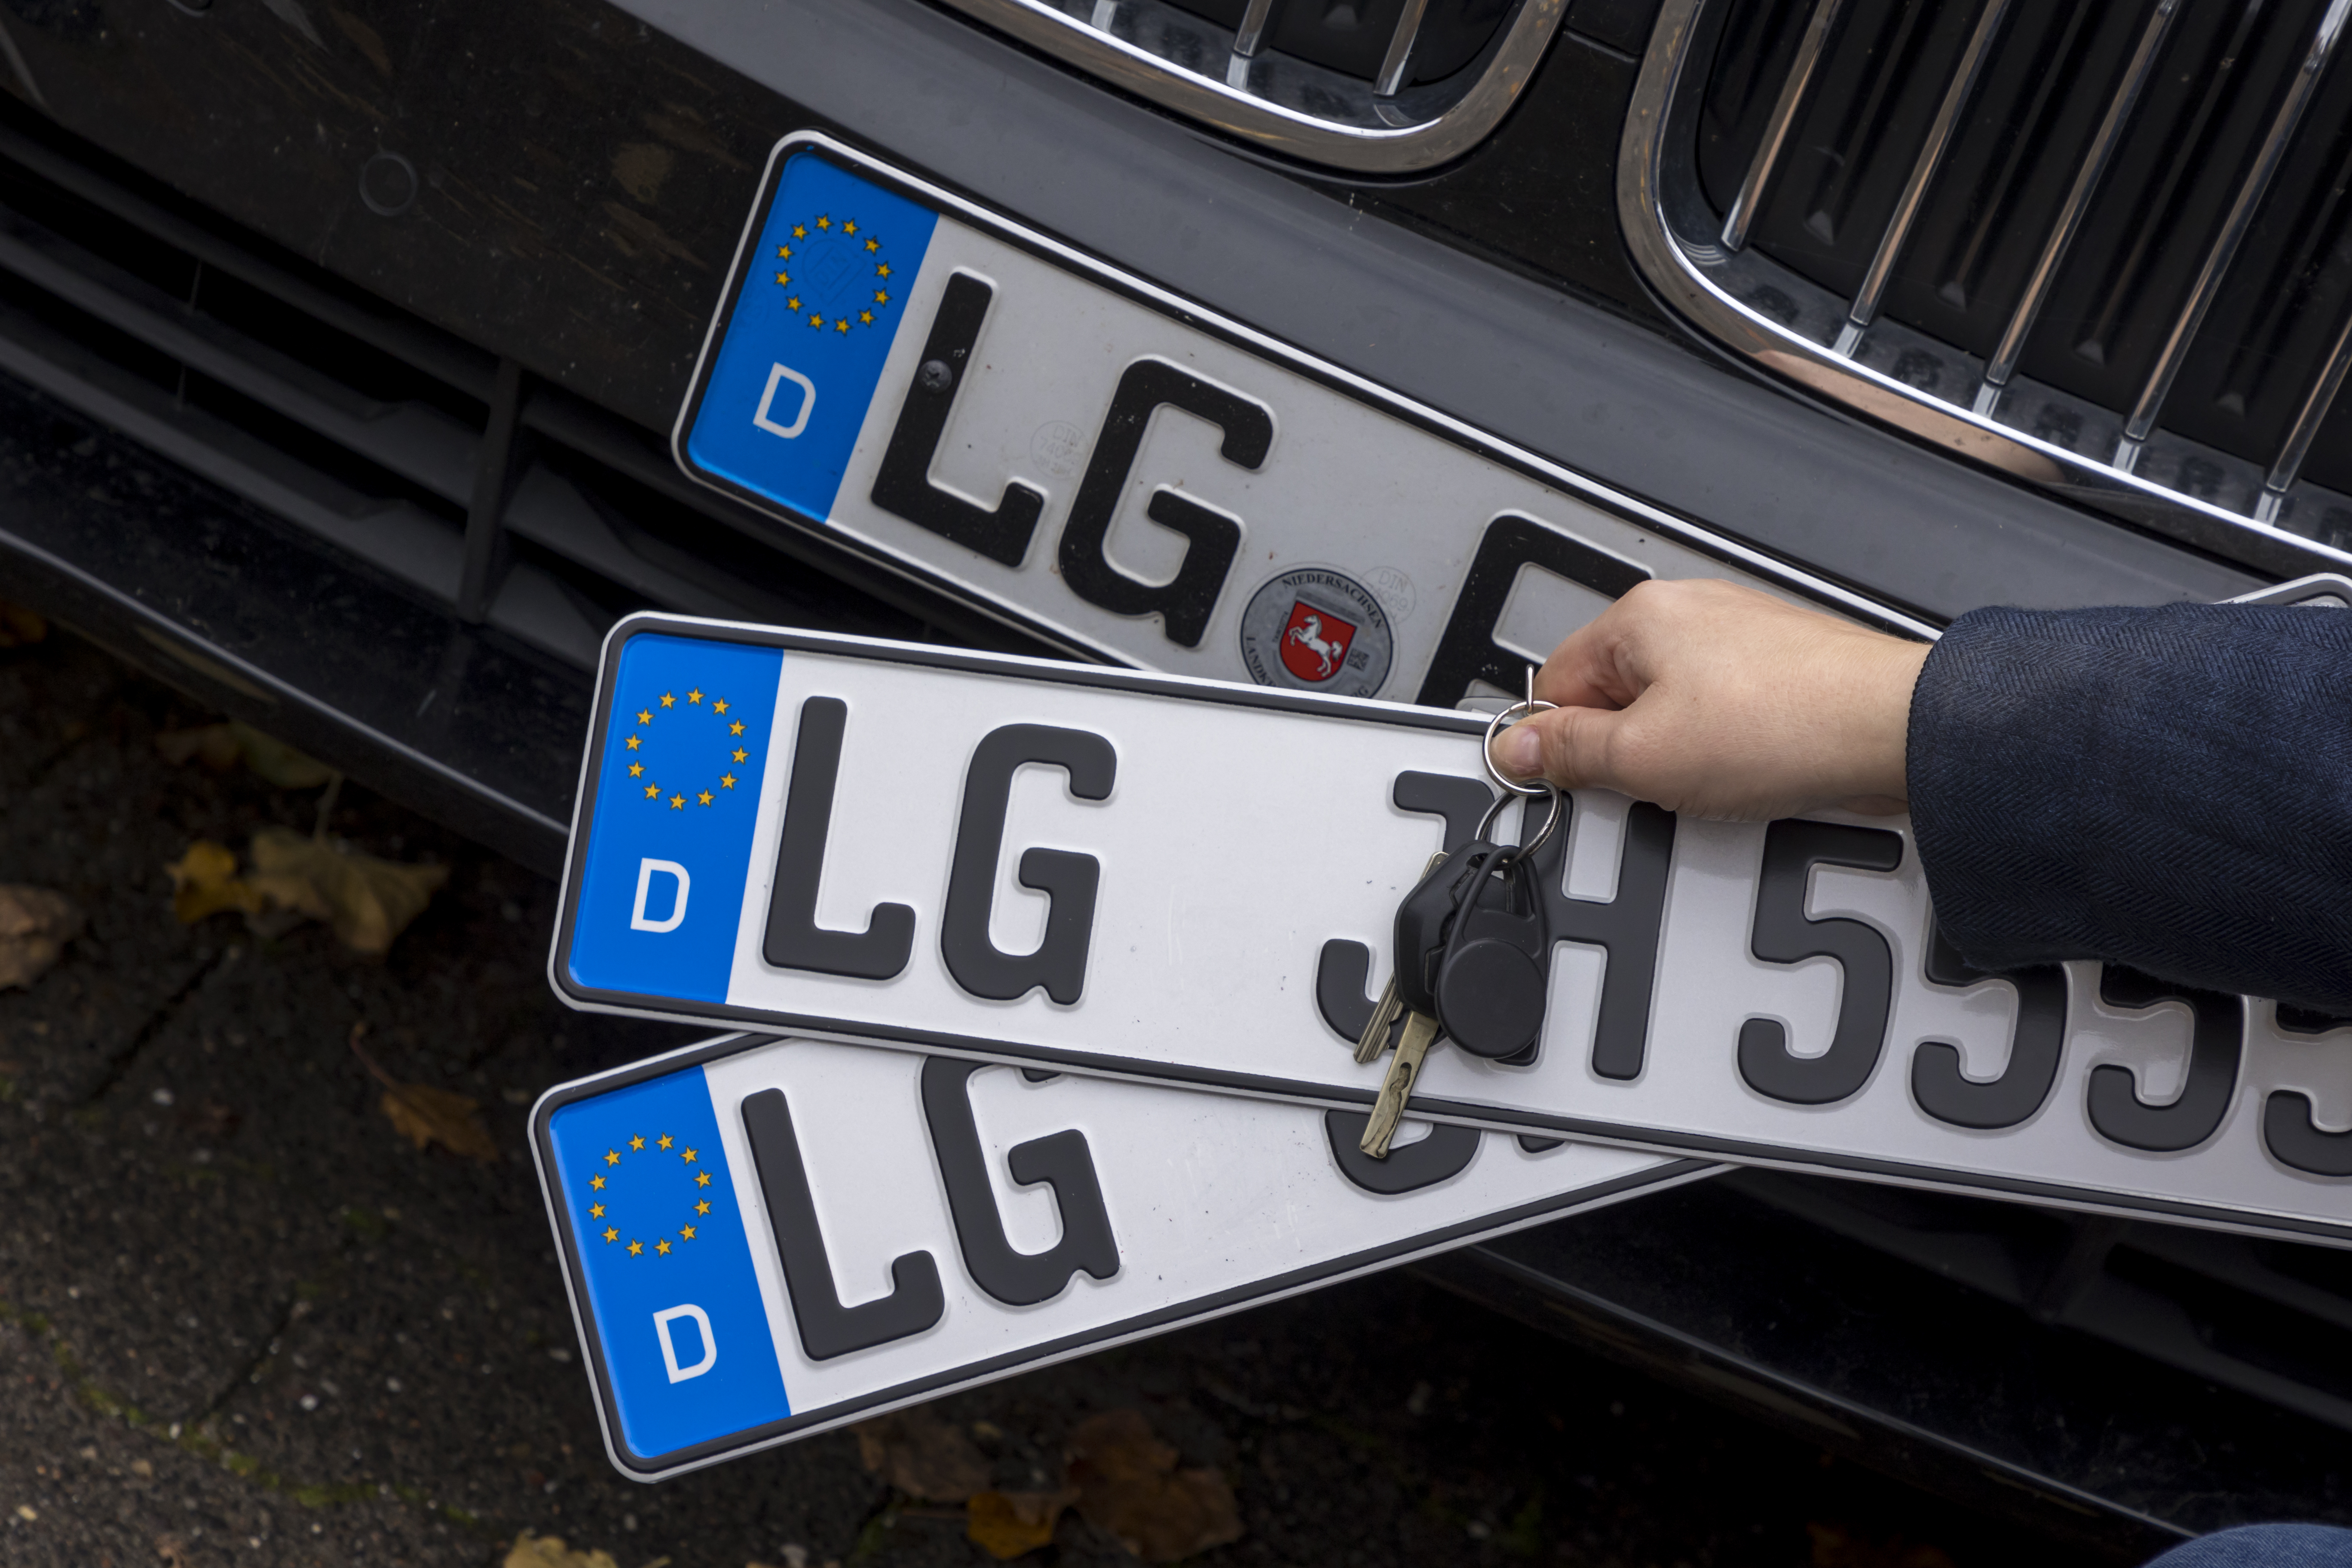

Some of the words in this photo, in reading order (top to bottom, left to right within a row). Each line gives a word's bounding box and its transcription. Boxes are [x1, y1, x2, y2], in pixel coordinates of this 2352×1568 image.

[753, 363, 815, 438] D
[870, 272, 1273, 649] LG
[1282, 573, 1382, 628] NIEDERSACHSEN
[1378, 570, 1409, 593] DIN
[763, 697, 1116, 1005] LG
[631, 858, 690, 933] D
[741, 1055, 1119, 1361] LG
[653, 1304, 717, 1384] D
